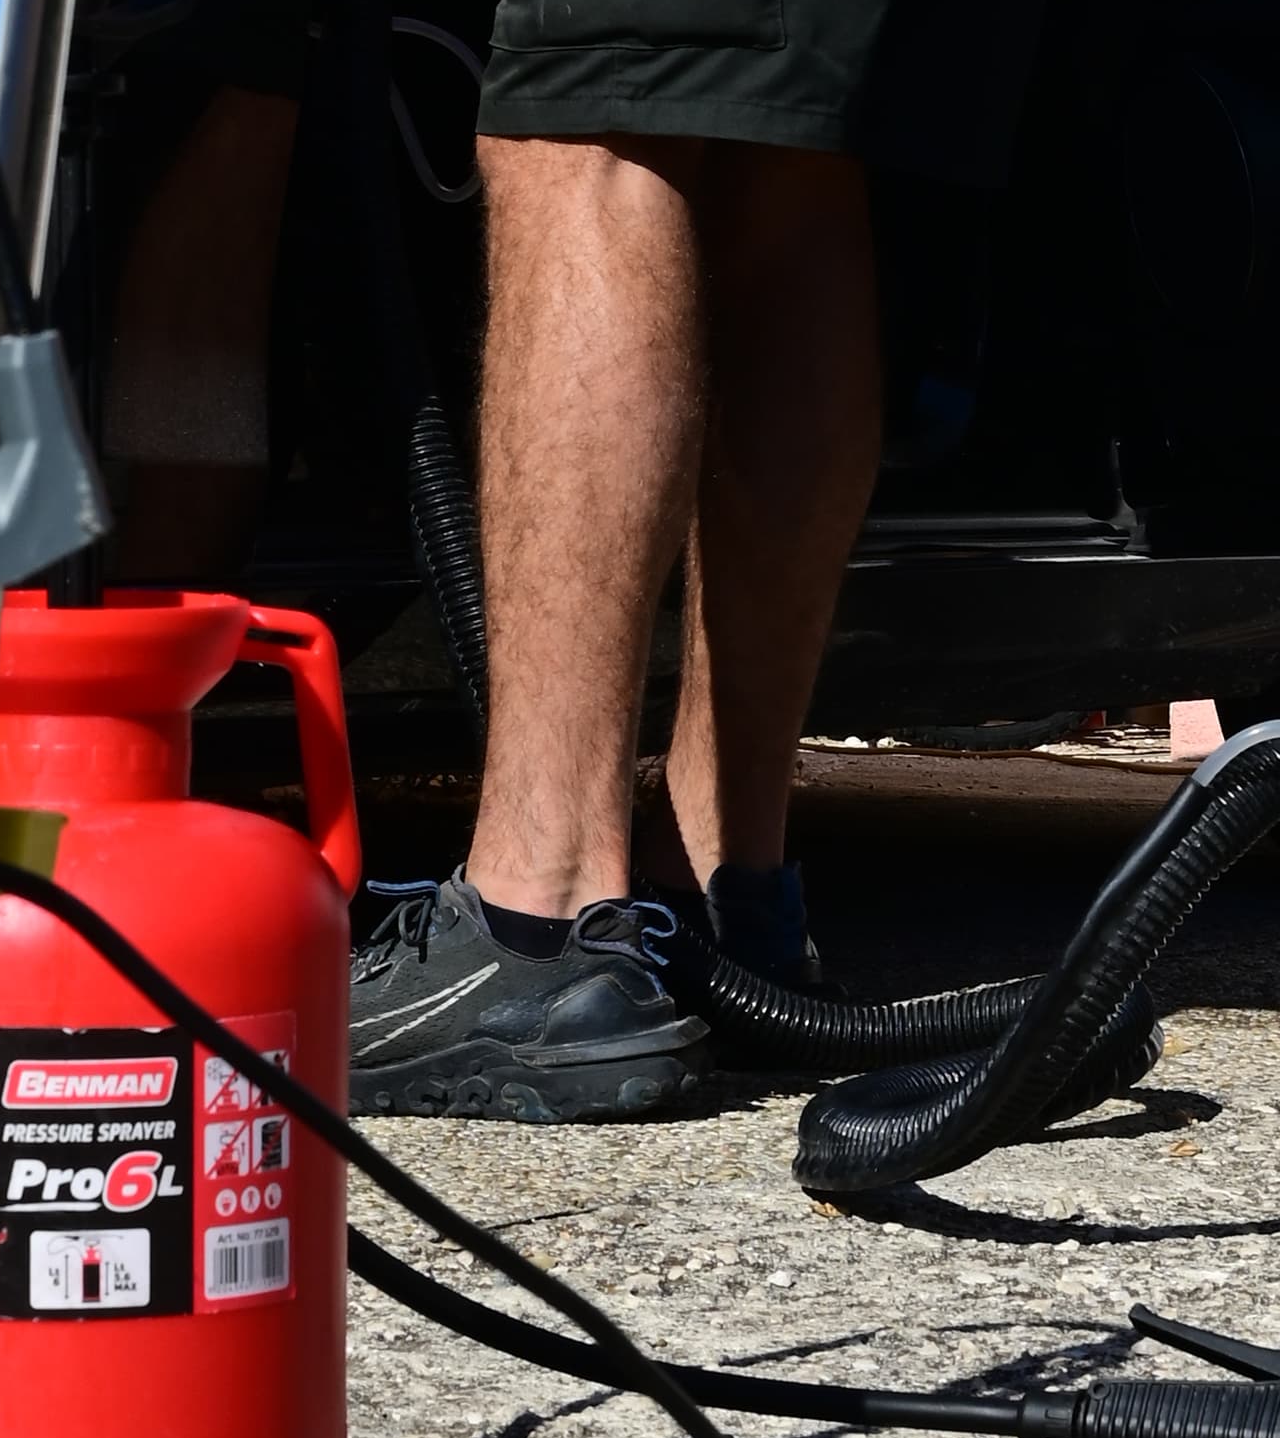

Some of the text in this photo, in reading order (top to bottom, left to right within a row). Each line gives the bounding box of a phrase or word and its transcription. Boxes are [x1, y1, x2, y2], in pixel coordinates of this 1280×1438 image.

[16, 1069, 164, 1098] BENMAN
[2, 1120, 176, 1143] PRESSURE SPRAYER
